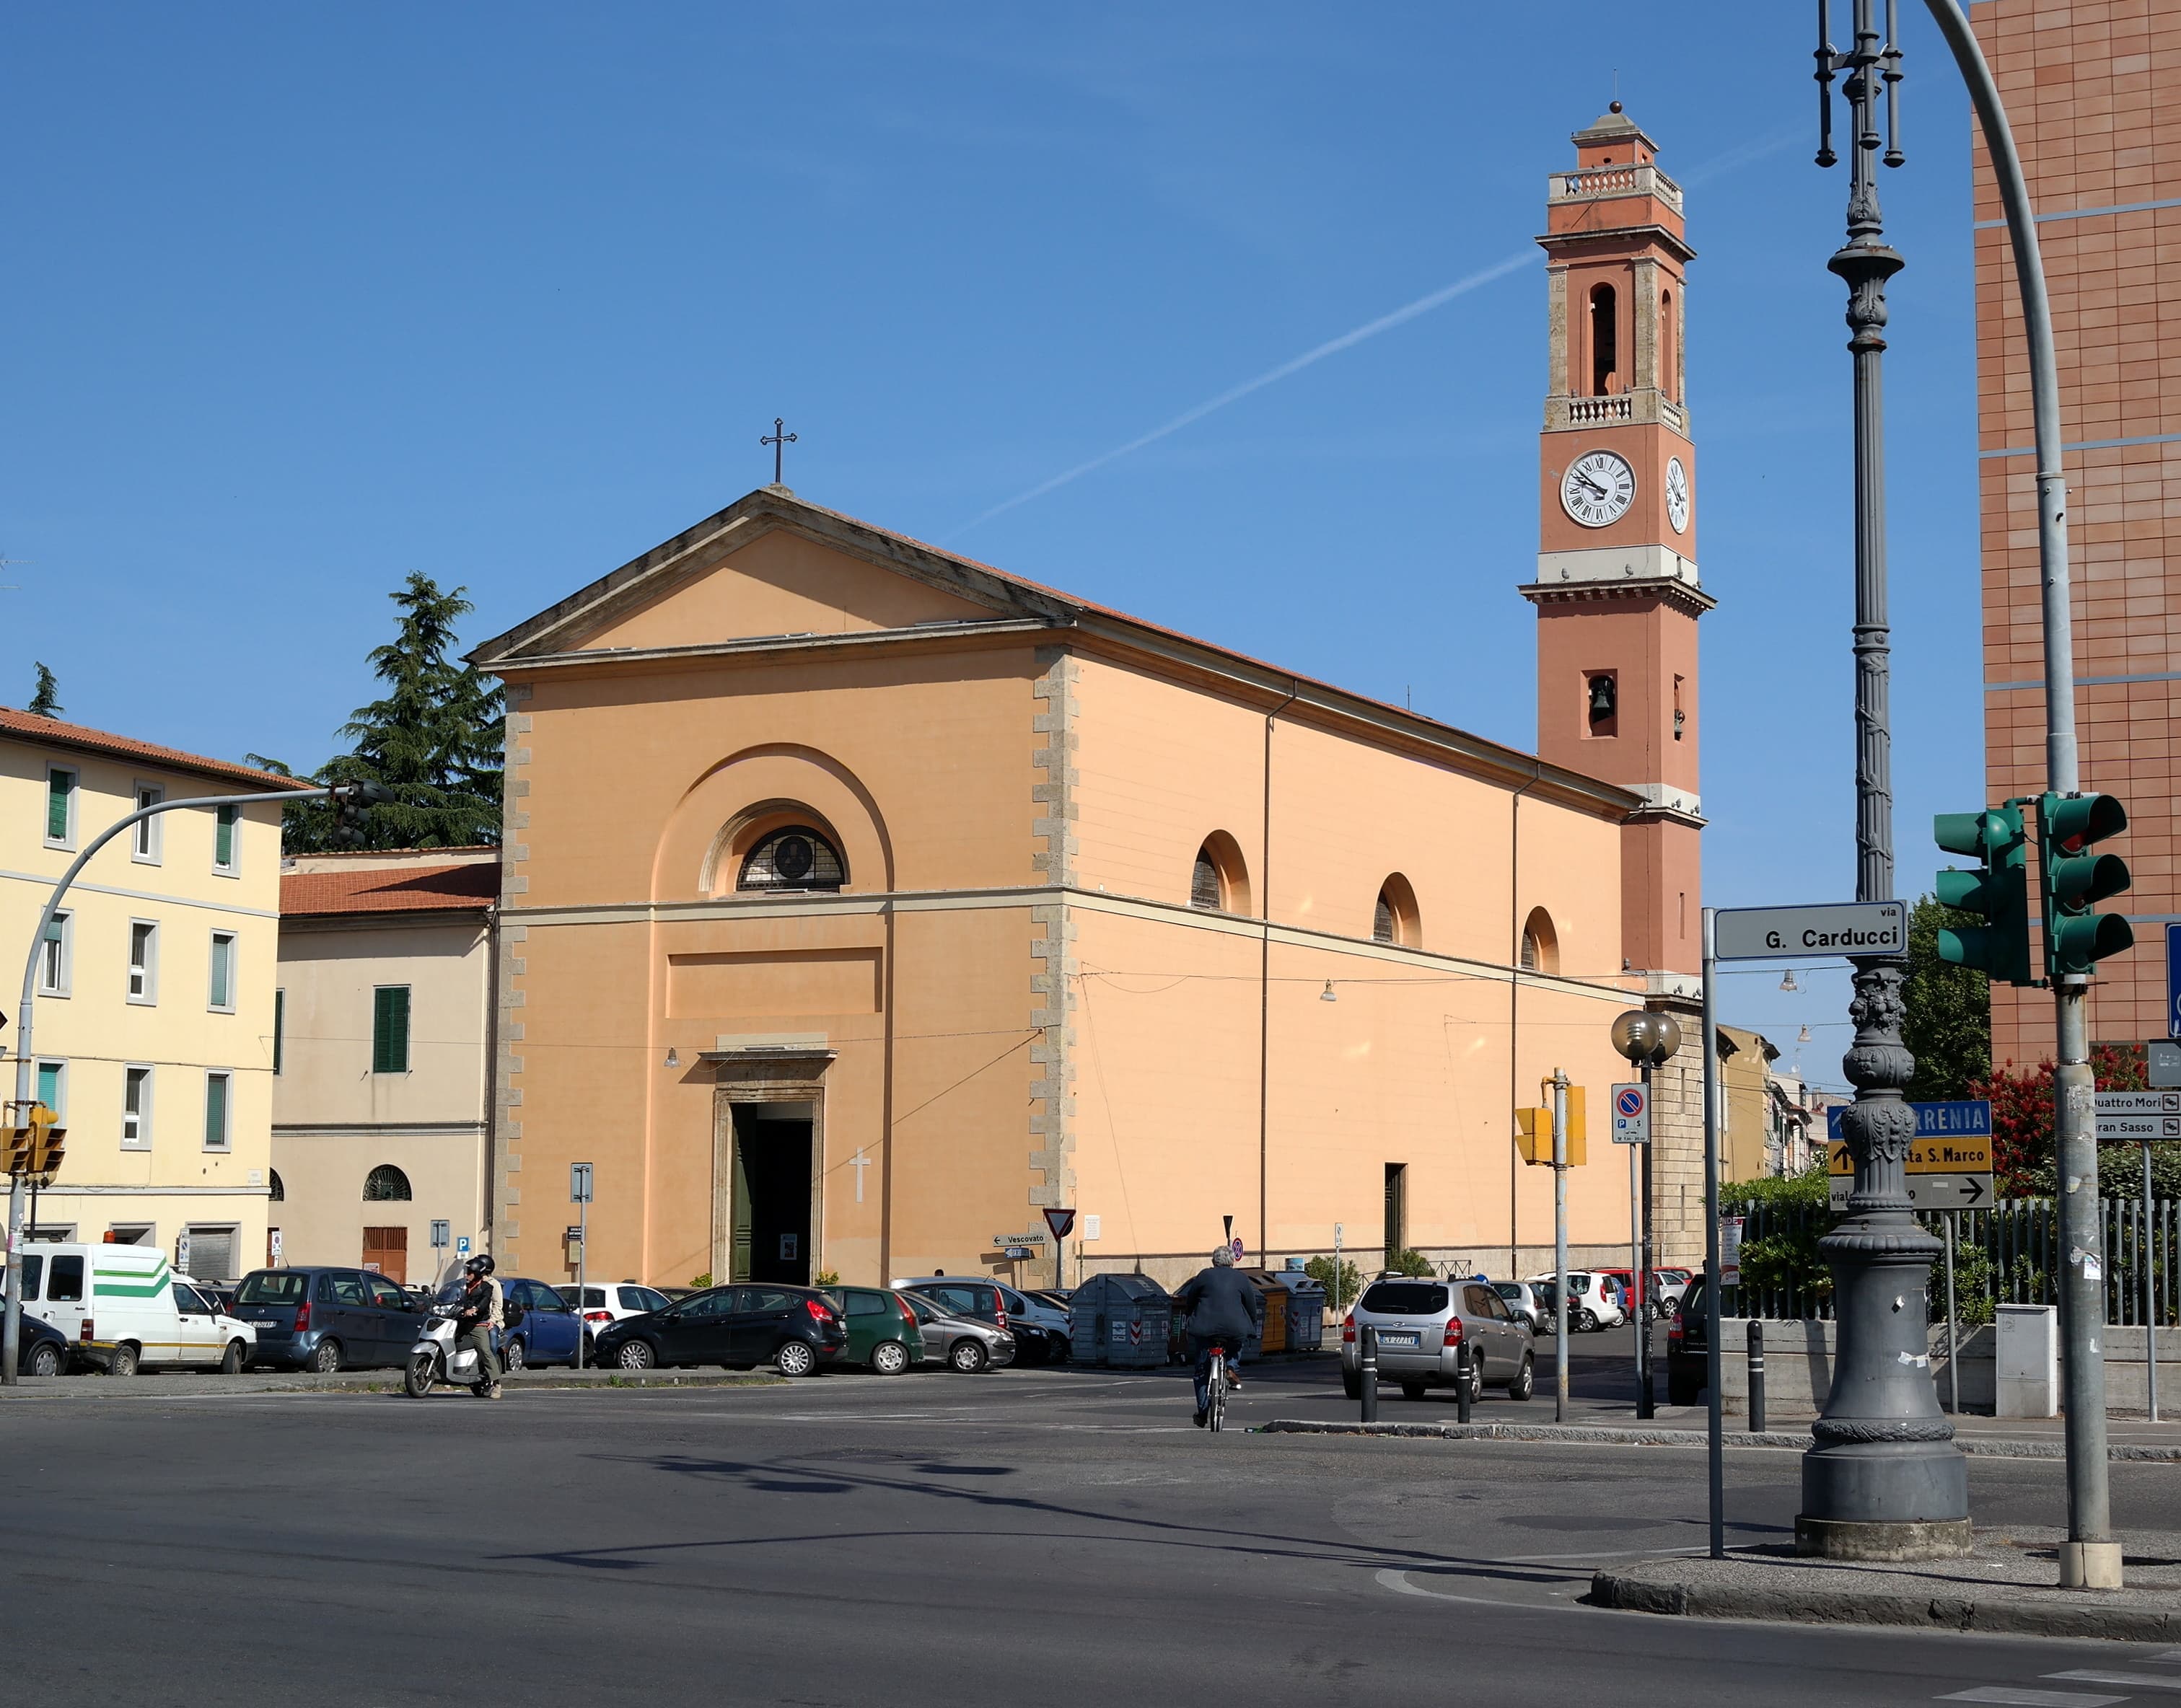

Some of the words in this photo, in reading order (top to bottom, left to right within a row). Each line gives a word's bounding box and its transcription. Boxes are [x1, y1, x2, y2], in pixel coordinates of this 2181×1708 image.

[1595, 457, 1604, 469] XII
[1880, 907, 1897, 917] via
[1765, 930, 1787, 949] G.
[1802, 925, 1898, 948] Carducci
[2094, 1098, 2133, 1107] uattro
[2135, 1097, 2161, 1107] Mori
[2120, 1122, 2154, 1132] Sasso
[1928, 1148, 1940, 1163] S.
[1943, 1147, 1984, 1163] Marco
[1831, 1190, 1851, 1202] vial
[1007, 1235, 1044, 1243] Vescovato
